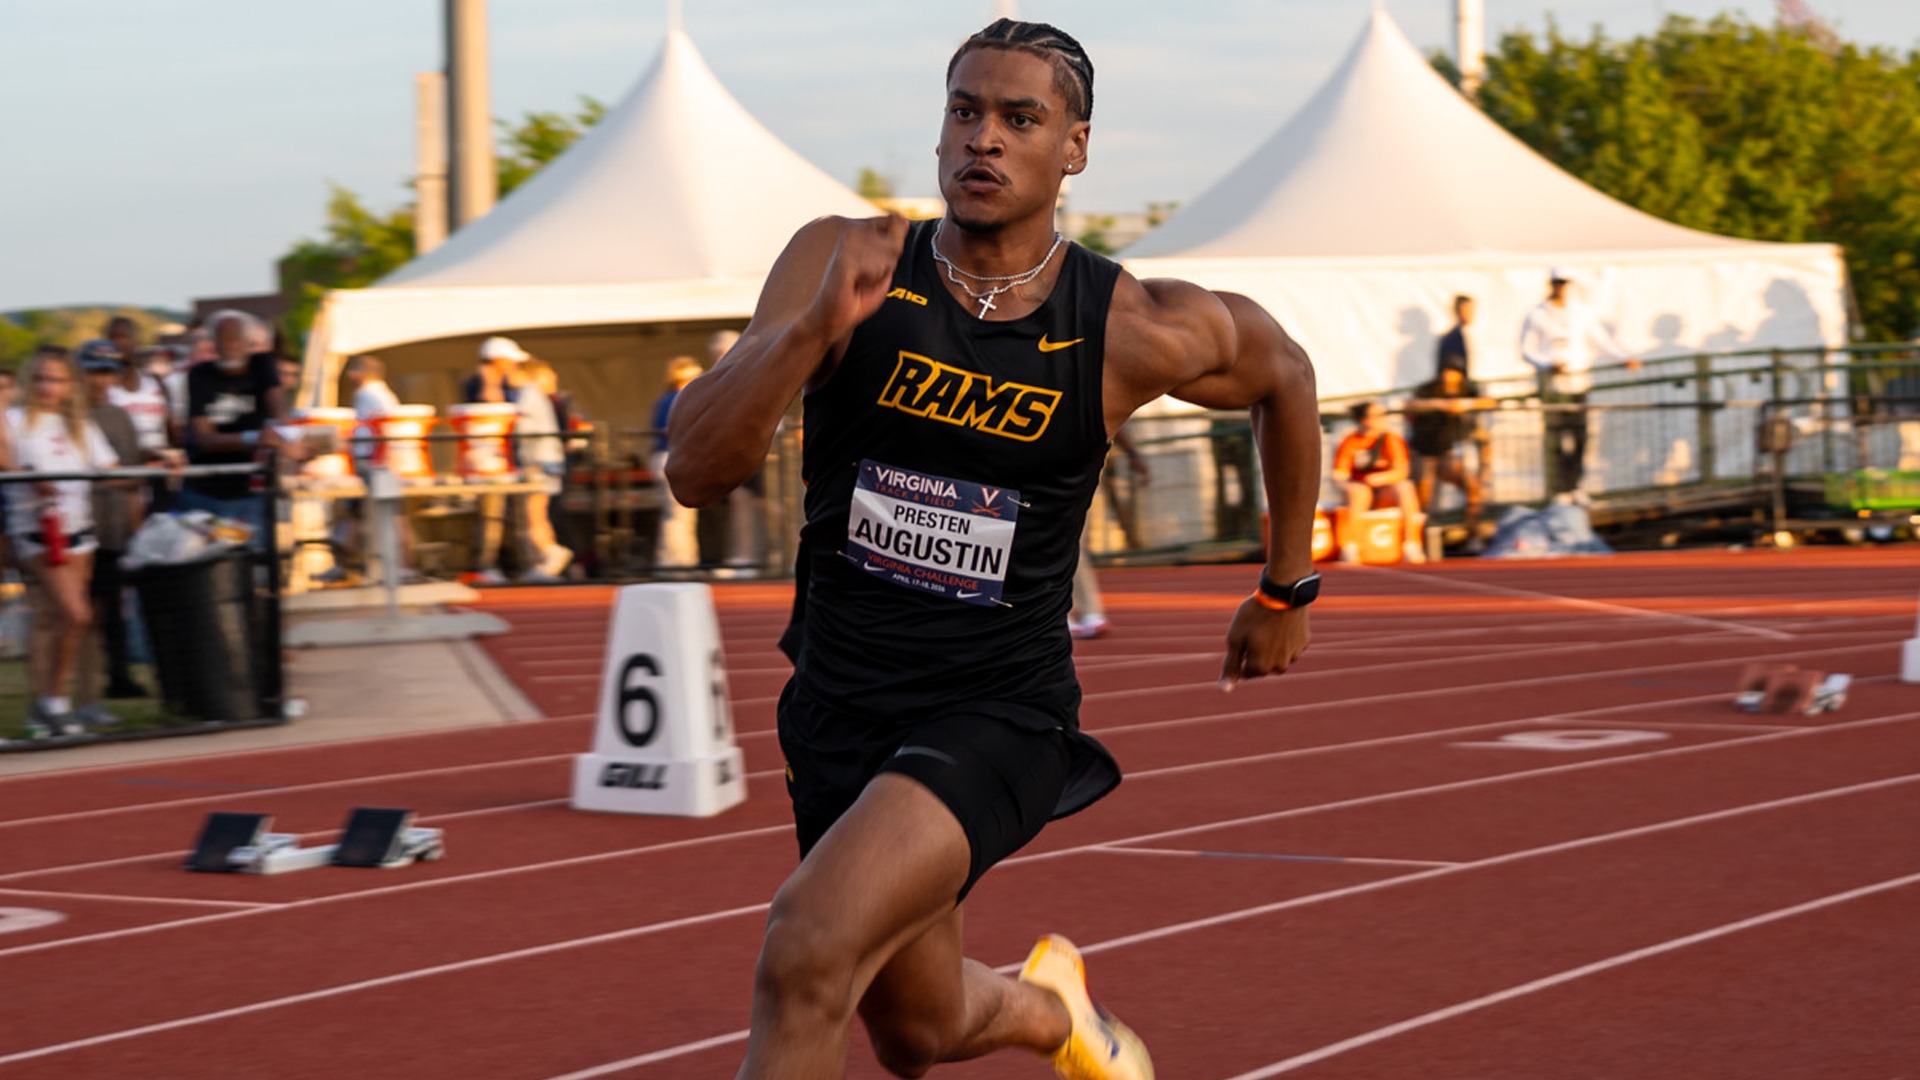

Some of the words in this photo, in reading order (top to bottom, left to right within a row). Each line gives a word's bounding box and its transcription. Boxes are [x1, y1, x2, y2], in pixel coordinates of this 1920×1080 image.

[877, 350, 1064, 442] RAMS
[875, 466, 958, 500] VIRGINIA
[875, 482, 909, 499] TRACK
[914, 493, 921, 502] &
[924, 495, 956, 508] FIELD
[893, 504, 971, 535] PRESTEN
[855, 517, 1003, 575] AUGUSTIN
[867, 553, 912, 575] VIRGINIA
[914, 567, 980, 590] CHALLENGE
[892, 573, 911, 584] APRIL
[618, 653, 663, 748] 6
